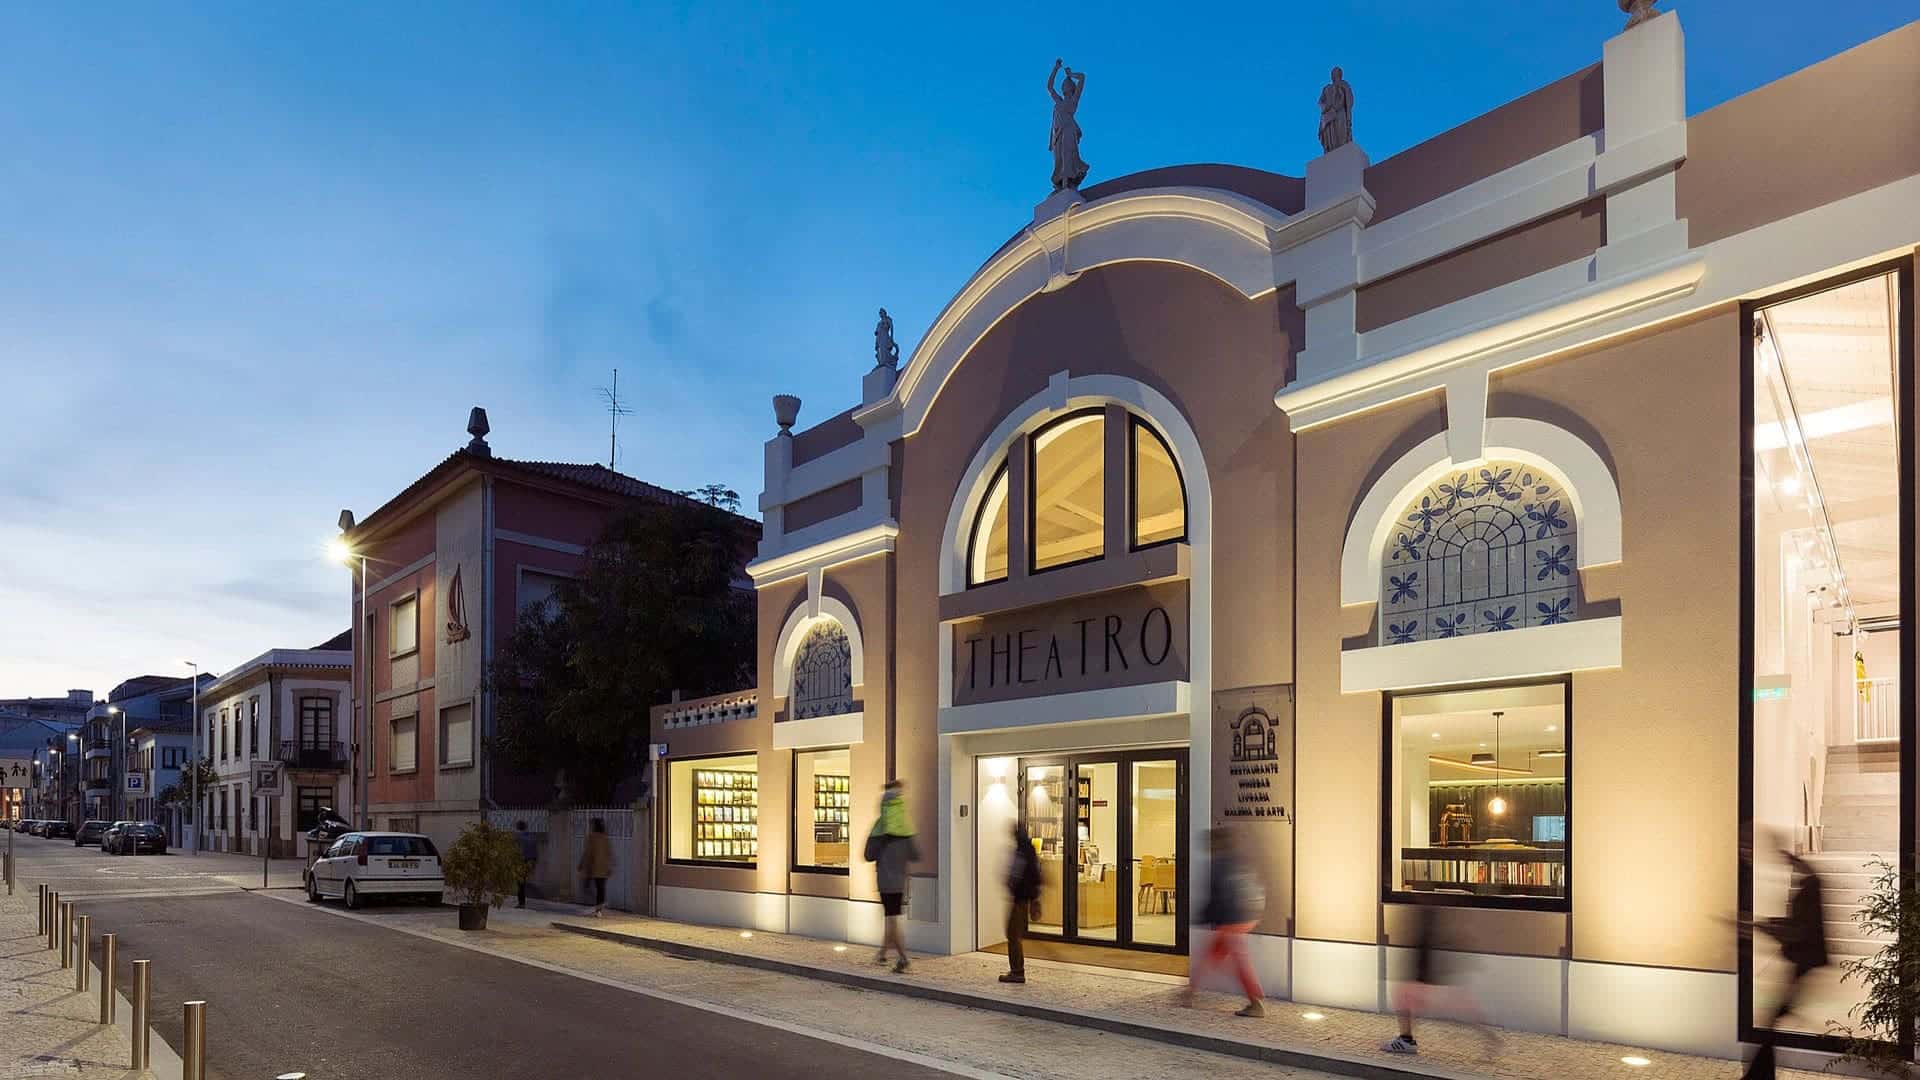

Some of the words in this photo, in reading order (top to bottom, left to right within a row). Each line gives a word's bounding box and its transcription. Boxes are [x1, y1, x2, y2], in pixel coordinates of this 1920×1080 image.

[964, 607, 1172, 689] THEATRO
[1230, 763, 1278, 775] RESTAURANTE
[130, 778, 138, 787] P
[1238, 792, 1270, 802] LIVRARIA
[1225, 807, 1252, 816] GALERIA
[1255, 807, 1265, 816] DE
[1267, 806, 1285, 816] ARTE
